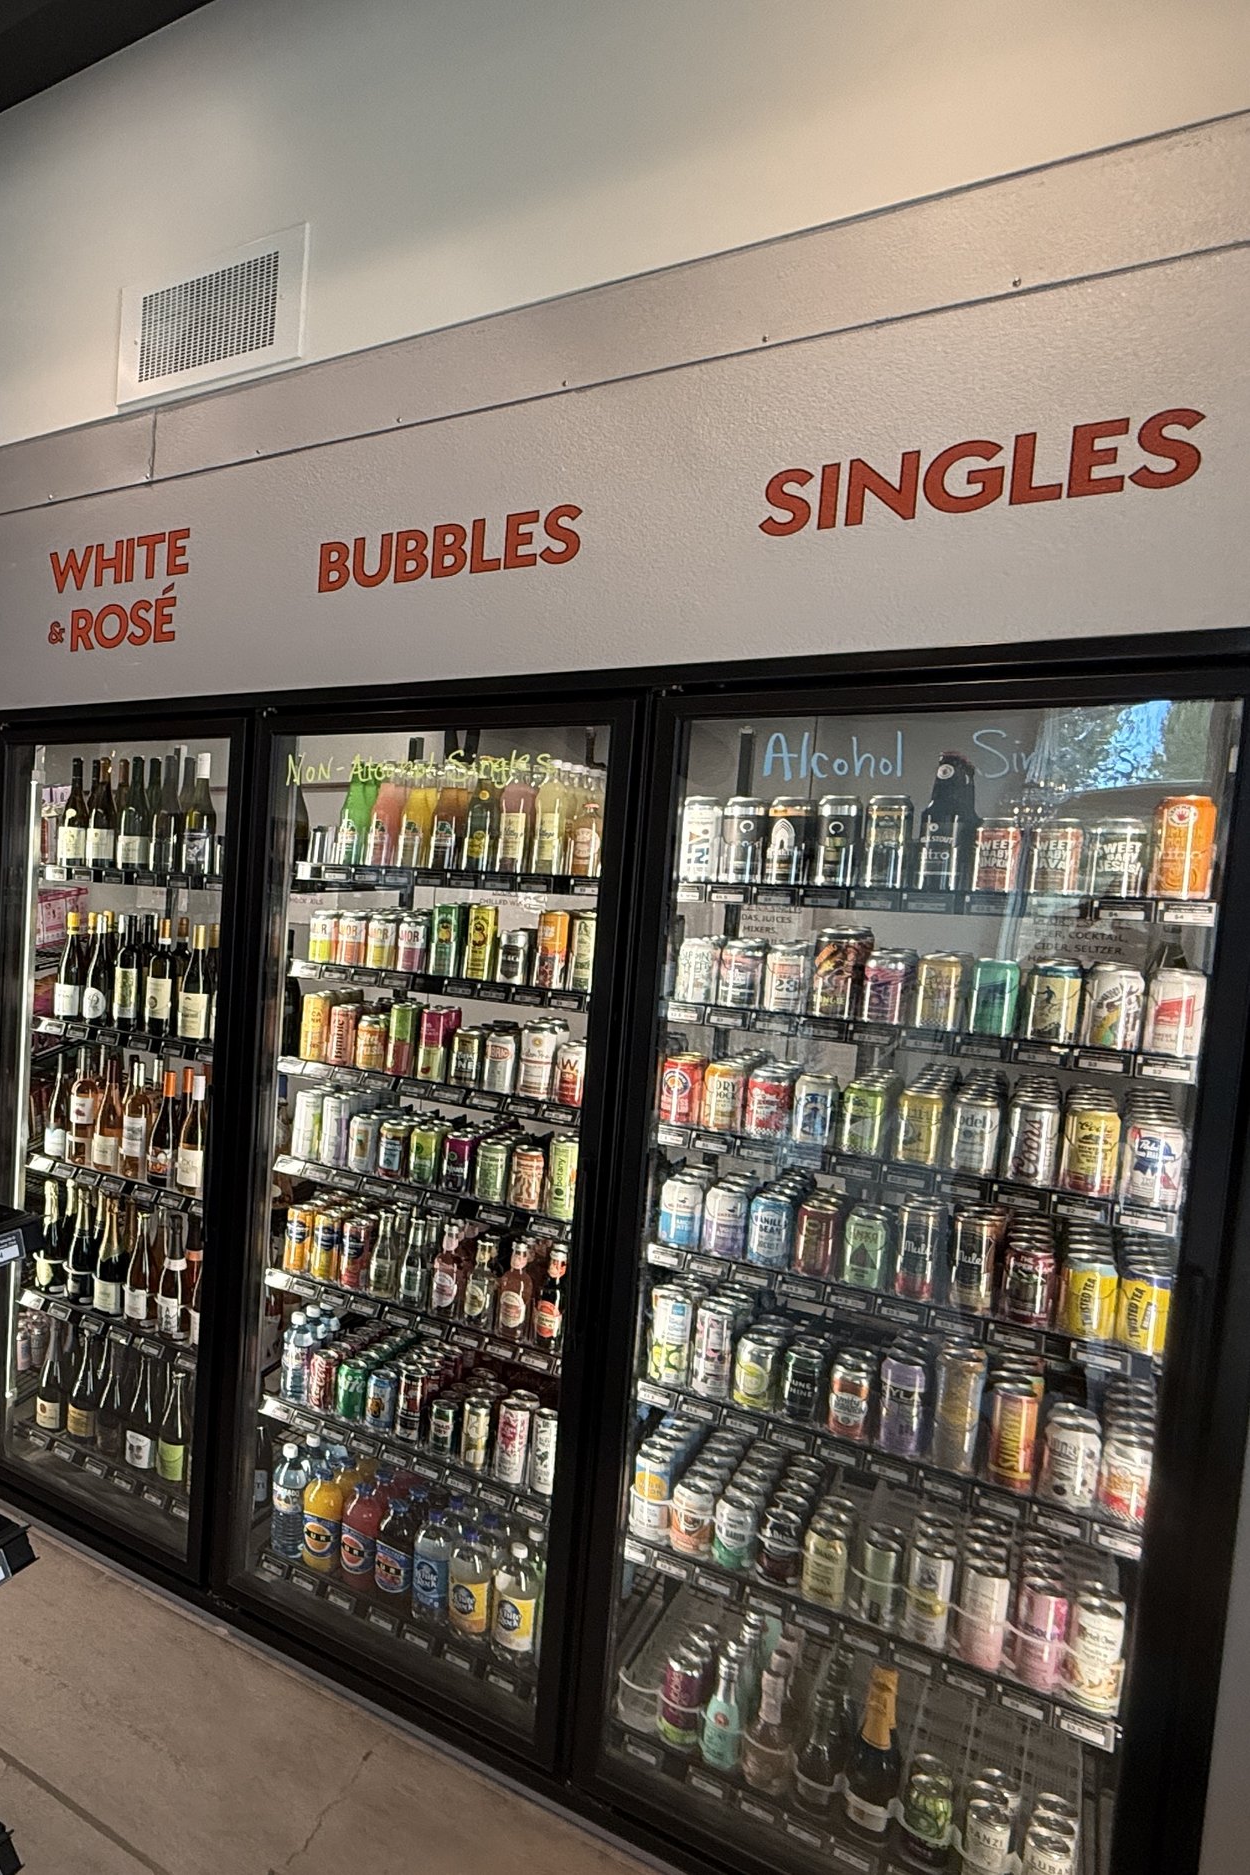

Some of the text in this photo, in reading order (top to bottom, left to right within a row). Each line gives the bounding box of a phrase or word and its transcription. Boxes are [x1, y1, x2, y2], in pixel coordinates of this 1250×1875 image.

[758, 408, 1206, 537] SINGLES
[50, 527, 191, 594] WHITE
[317, 504, 584, 593] BUBBLES
[48, 583, 177, 652] & ROSÉ
[446, 749, 558, 789] Singles
[762, 730, 904, 782] Alcohol
[762, 915, 792, 924] JUICES
[1011, 1118, 1043, 1180] Coors
